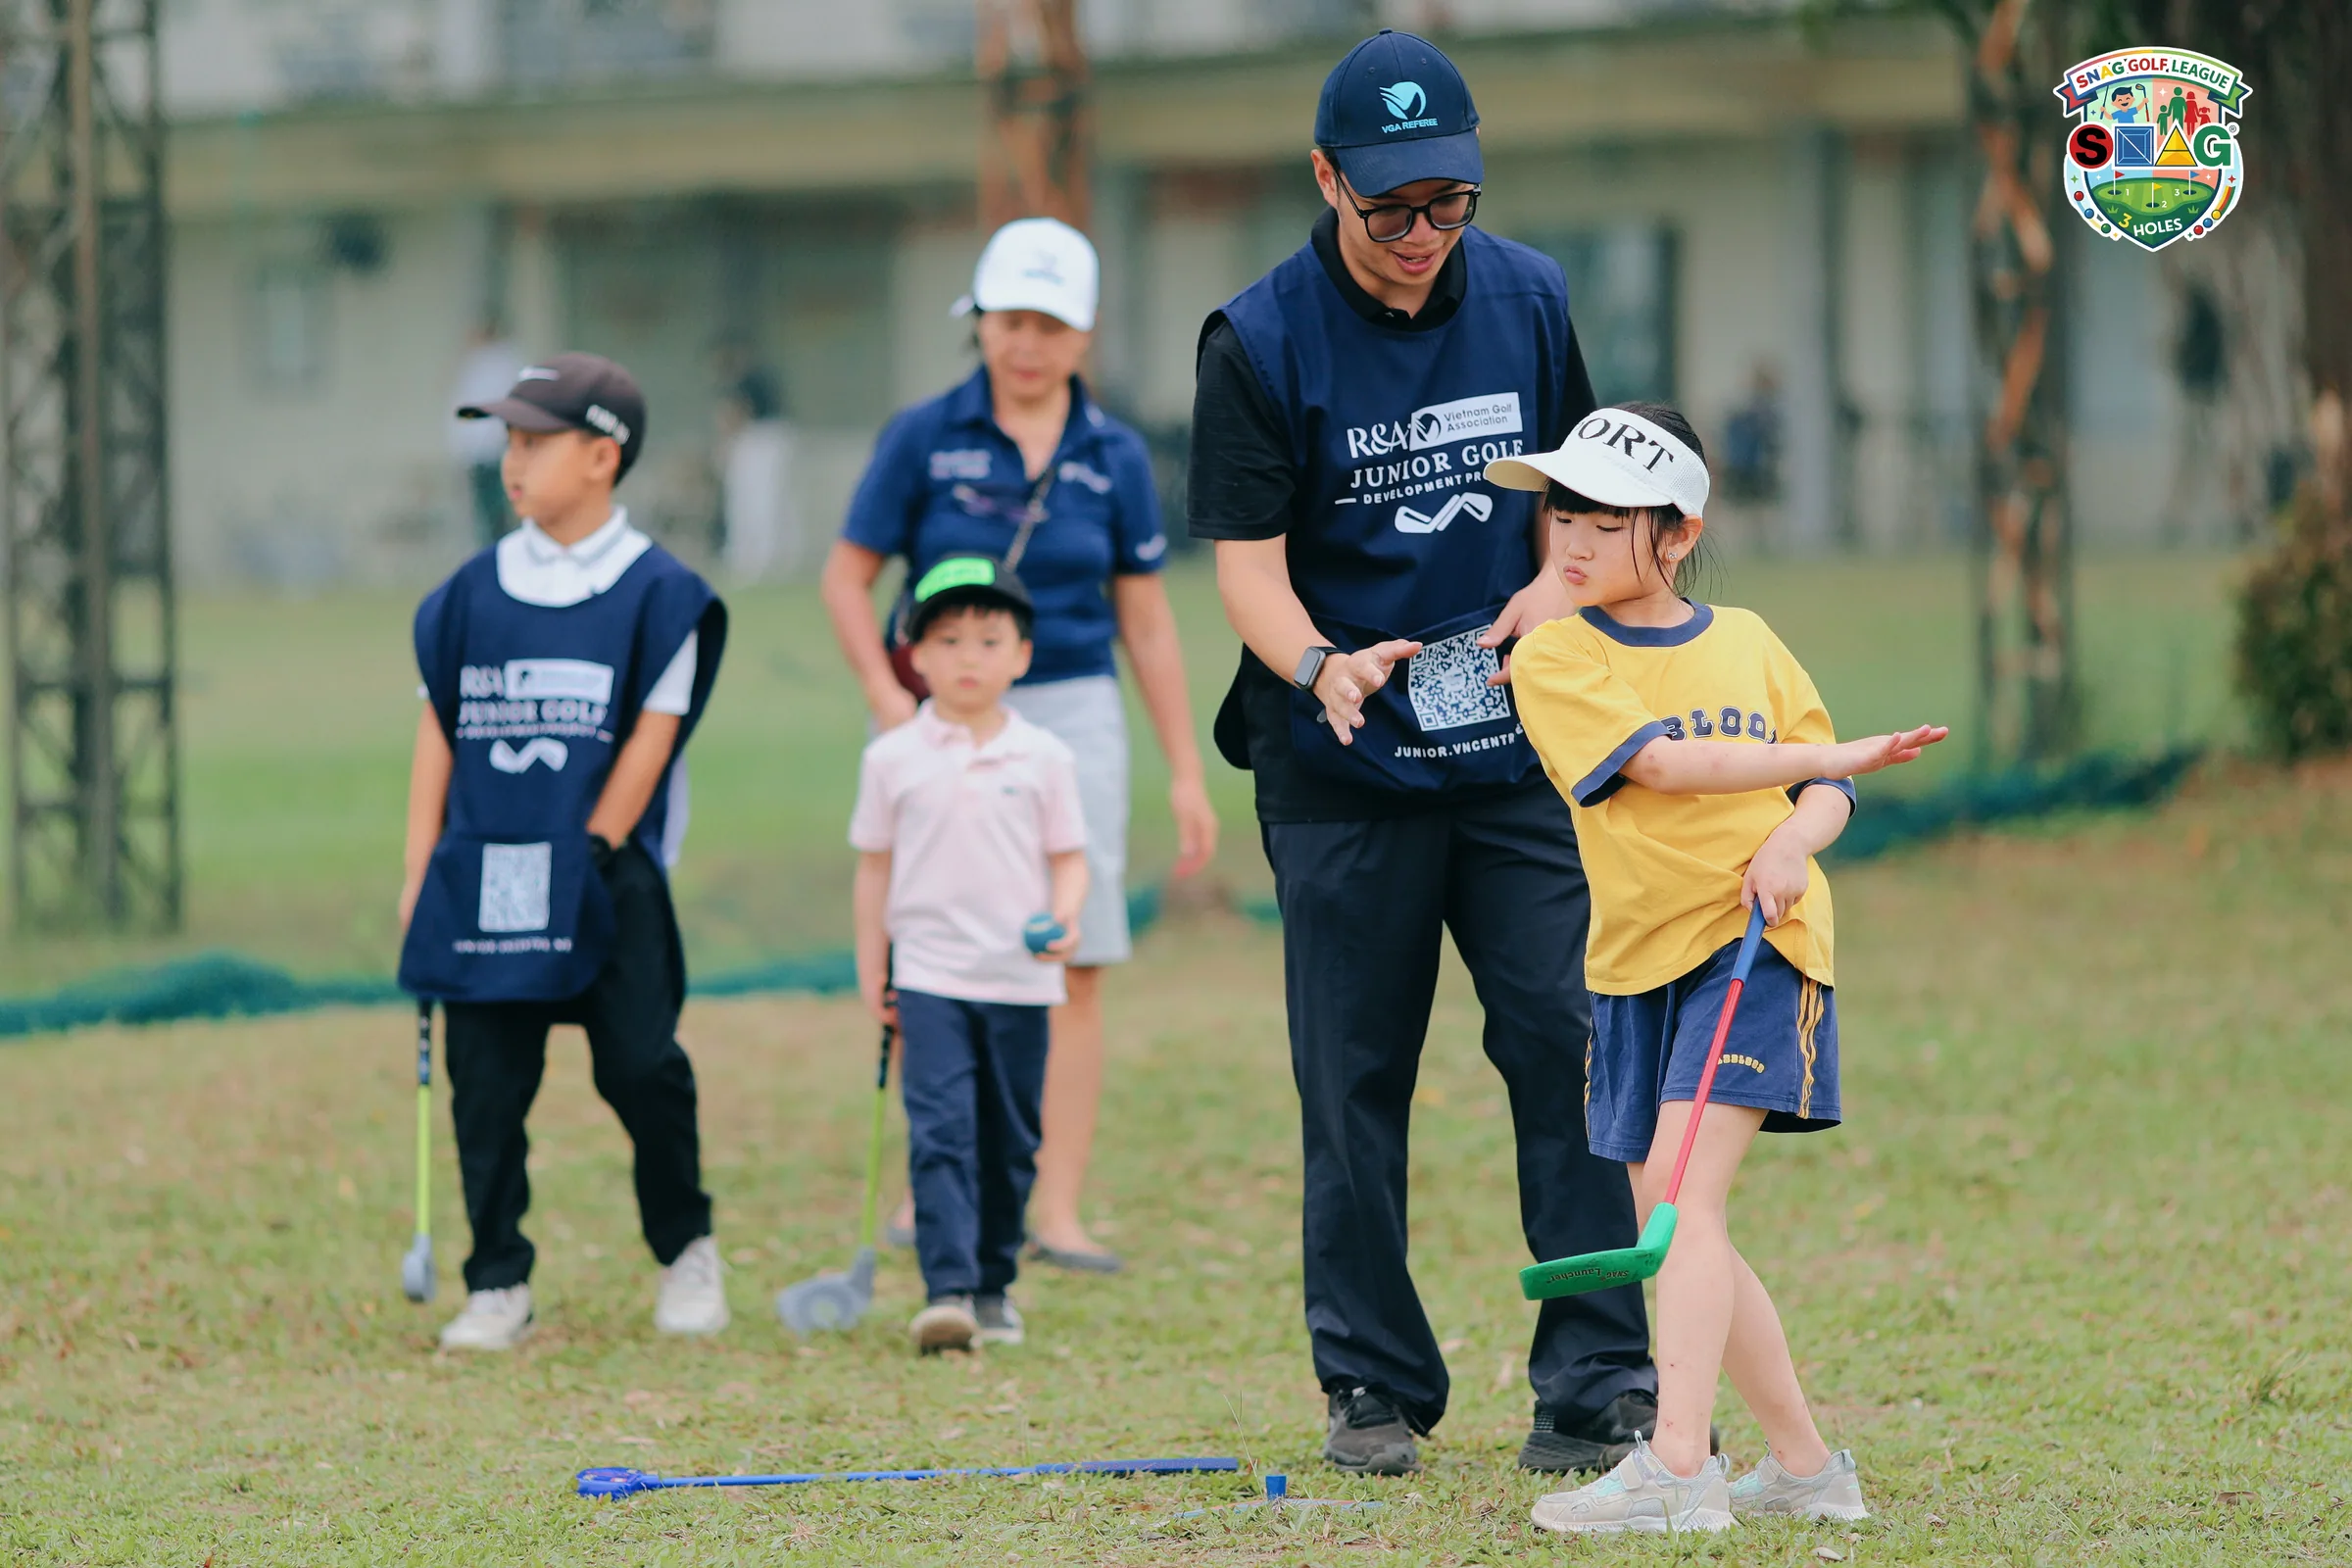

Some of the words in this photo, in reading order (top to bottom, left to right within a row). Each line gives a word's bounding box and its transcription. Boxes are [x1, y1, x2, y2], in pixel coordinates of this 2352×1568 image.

[1381, 123, 1402, 134] VGA
[1401, 118, 1439, 130] REFEREE
[1444, 407, 1490, 422] Vietnam
[1492, 403, 1512, 415] Golf
[1446, 416, 1508, 432] Association
[1347, 419, 1411, 459] R&A
[1350, 452, 1452, 488] JUNIOR
[1461, 439, 1523, 466] GOLF
[1363, 474, 1463, 505] DEVELOPMENT
[1465, 470, 1486, 484] PR
